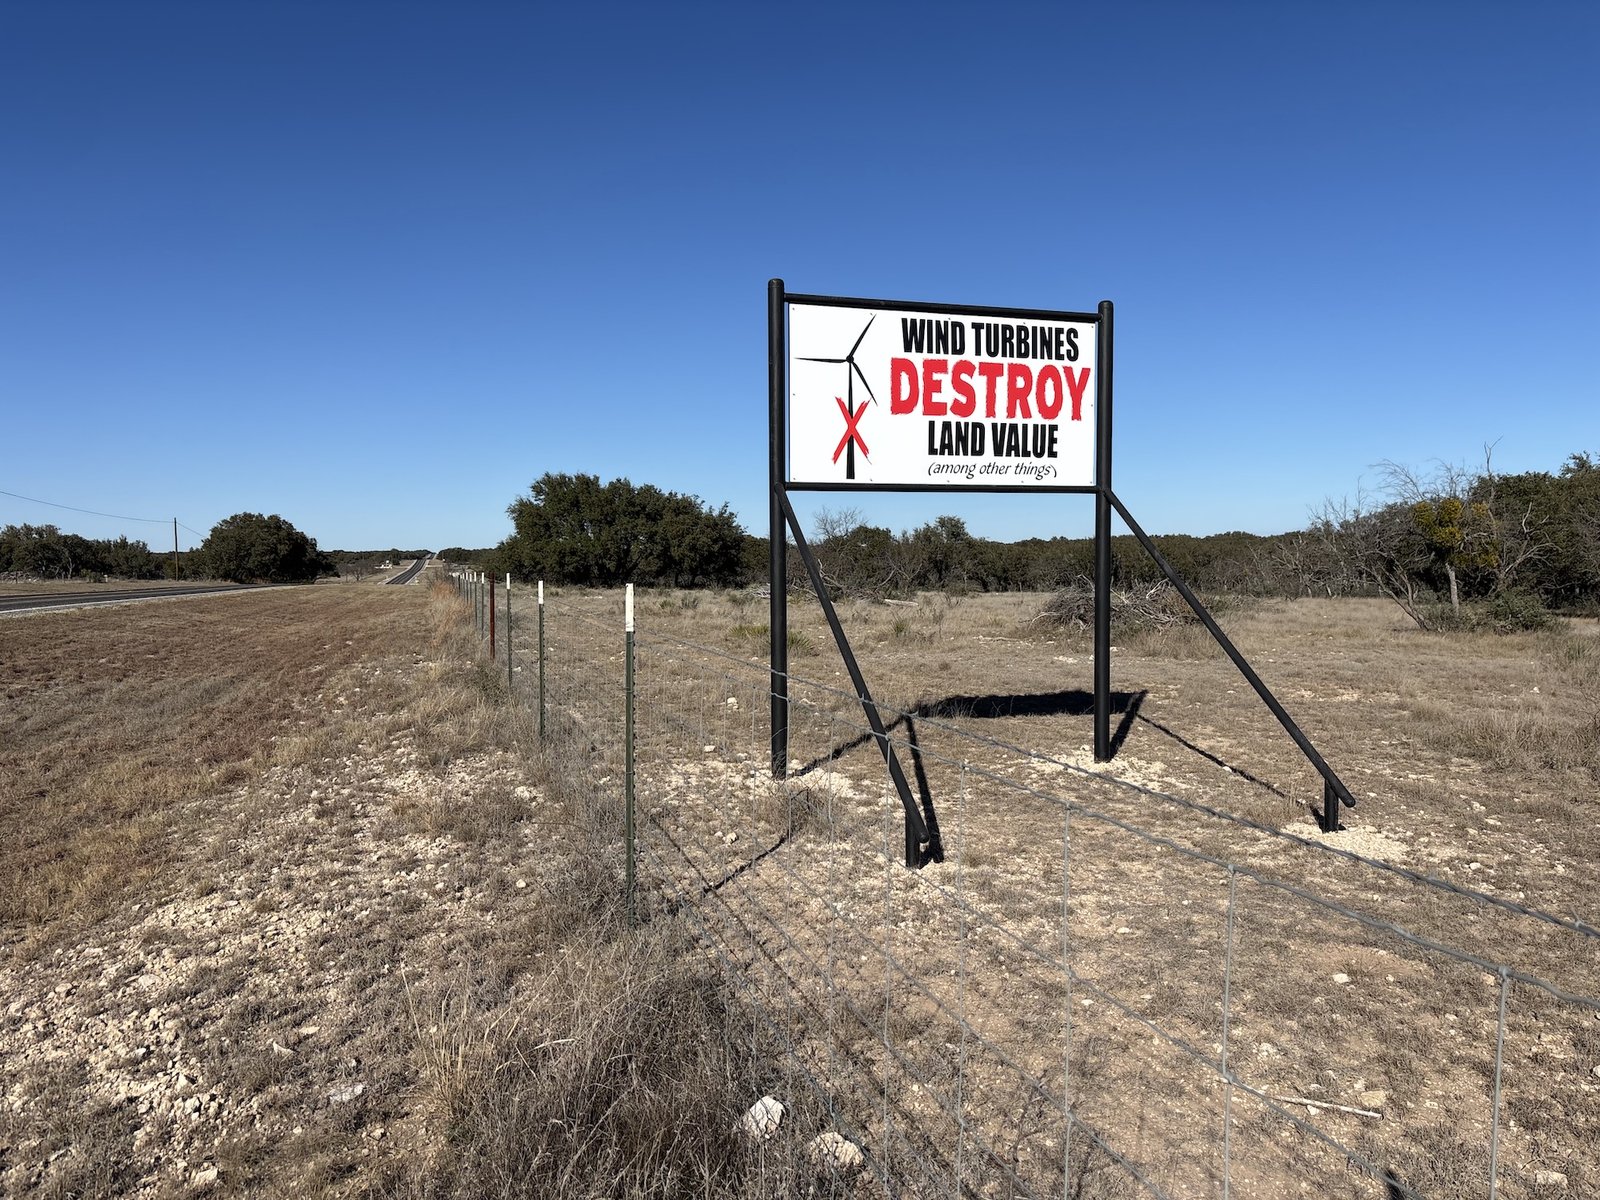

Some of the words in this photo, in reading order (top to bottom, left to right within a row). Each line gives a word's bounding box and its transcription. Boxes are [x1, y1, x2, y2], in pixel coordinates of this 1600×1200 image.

[901, 317, 966, 356] WIND
[971, 322, 1079, 362] TURBINES
[890, 357, 1091, 421] DESTROY
[928, 420, 986, 457] LAND
[991, 422, 1058, 458] VALUE
[927, 461, 976, 479] (among
[979, 462, 1011, 477] other
[1014, 463, 1057, 481] things)
